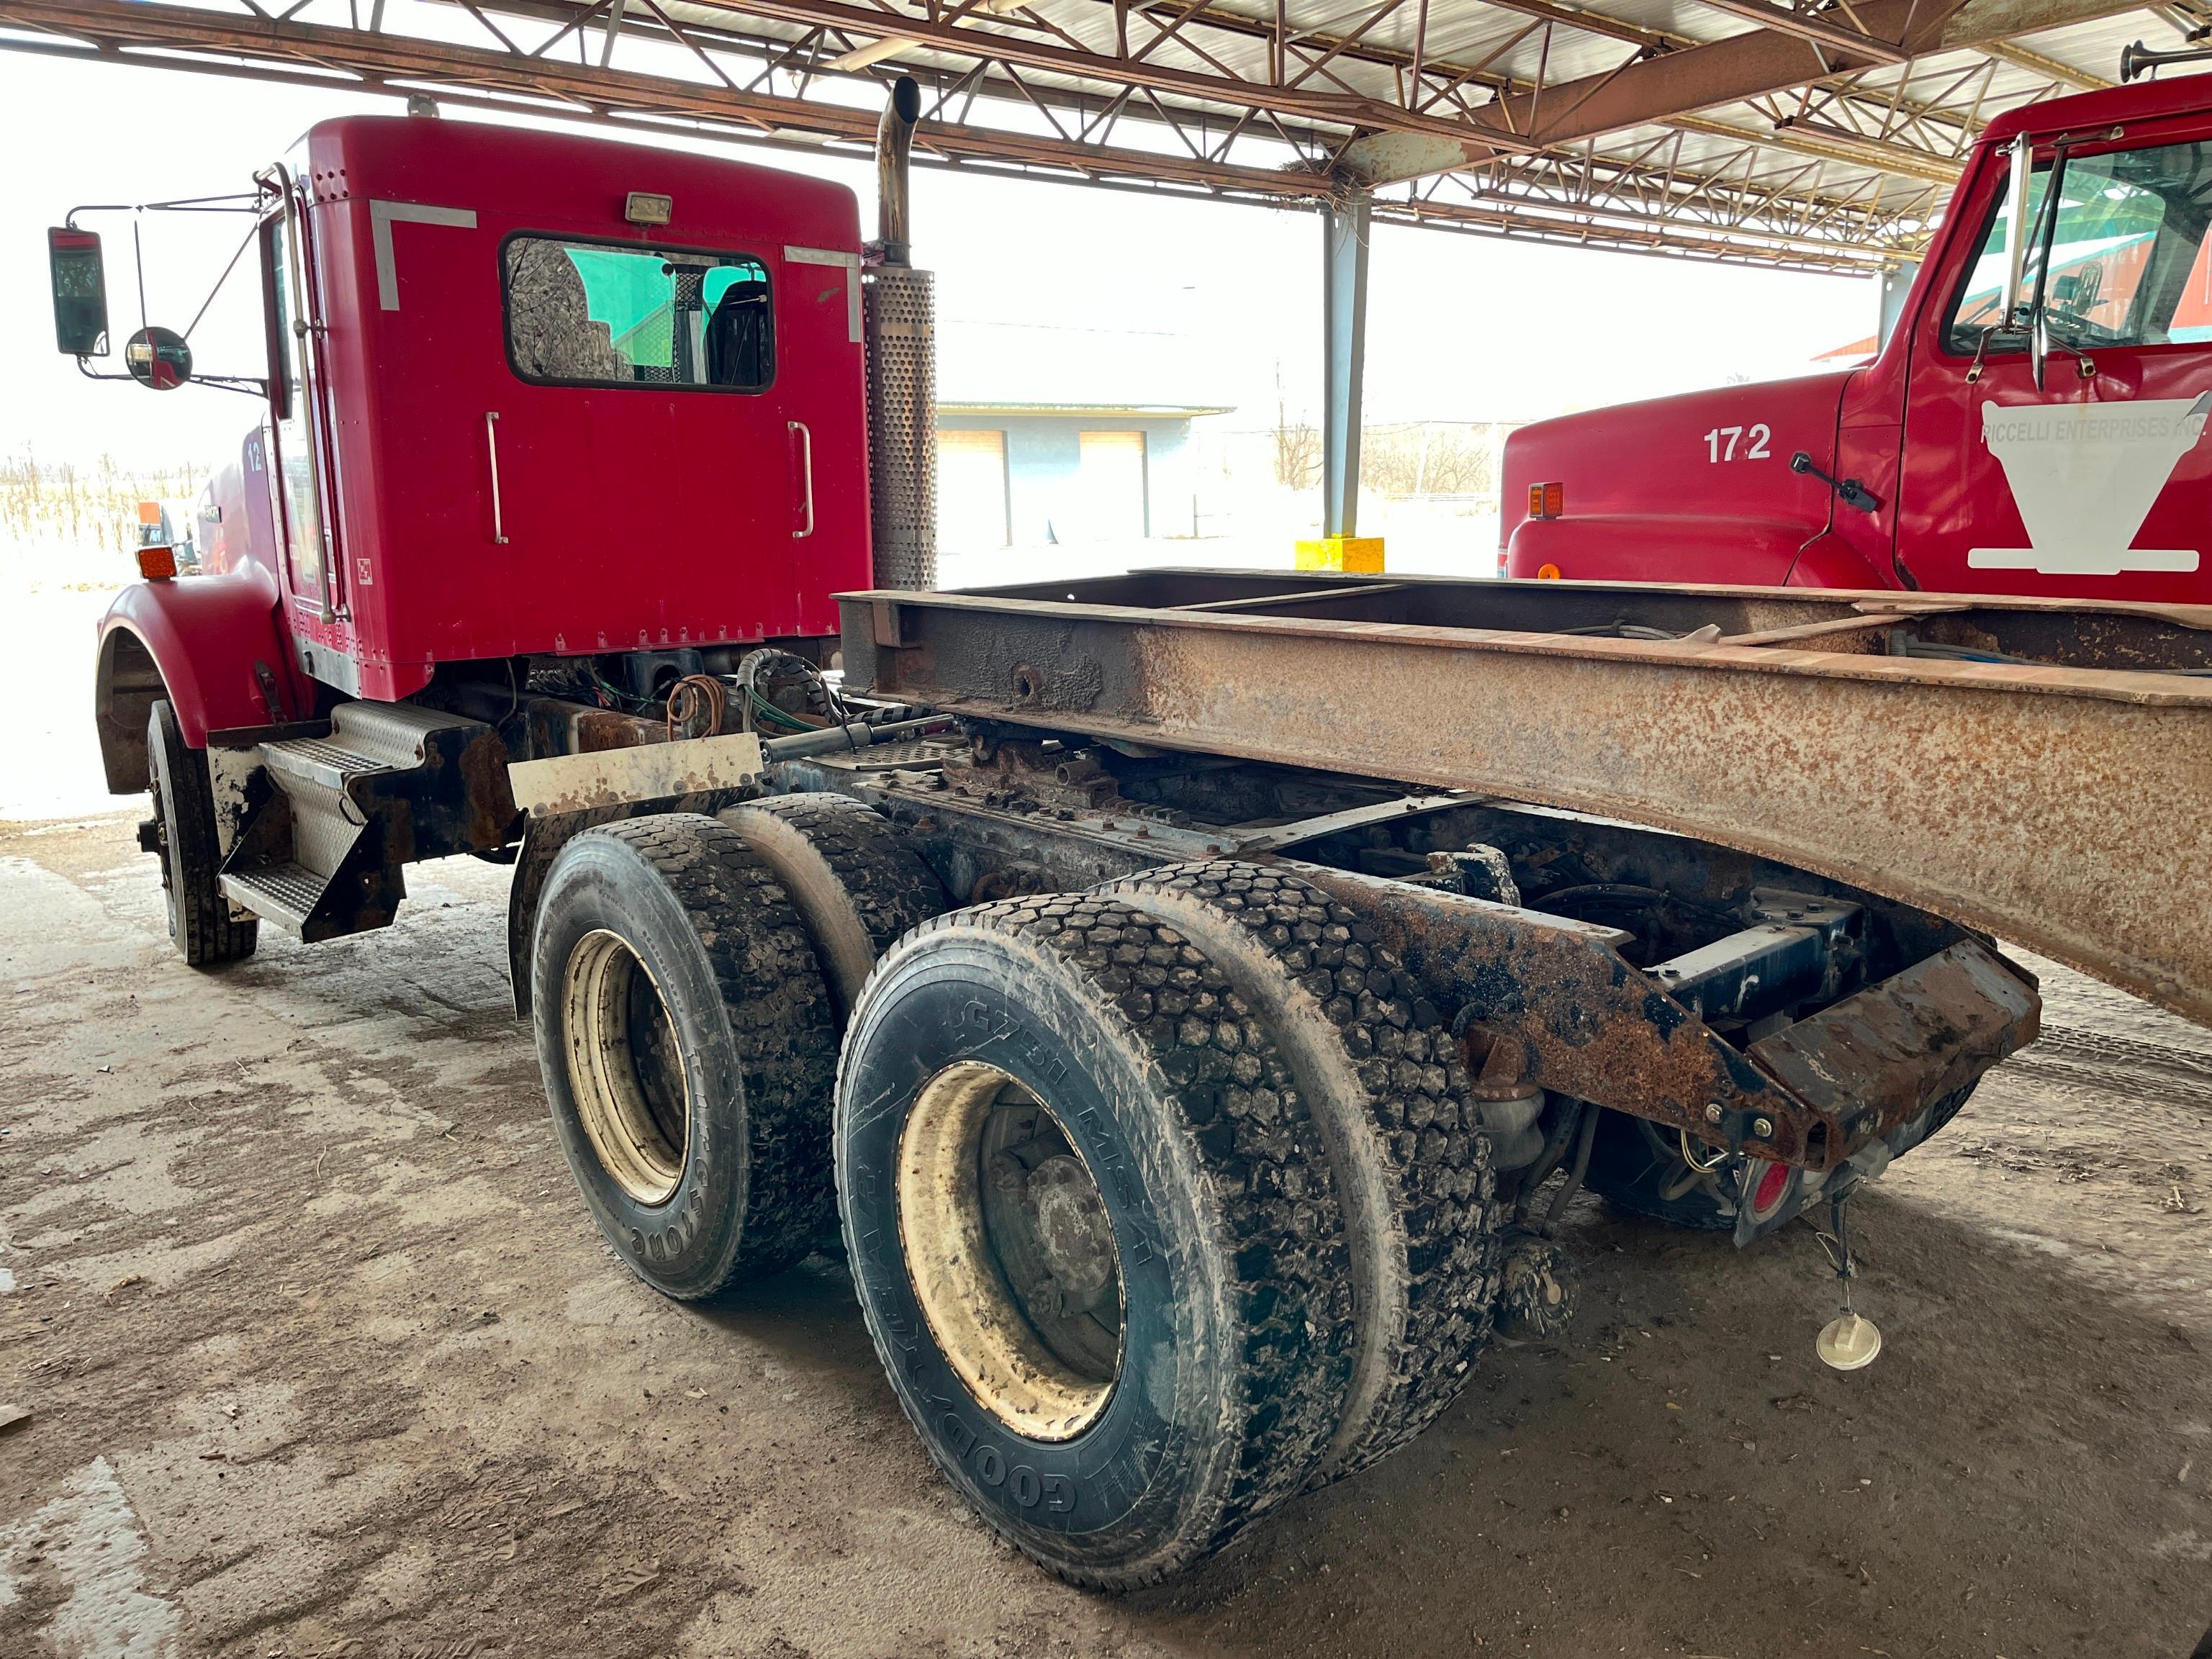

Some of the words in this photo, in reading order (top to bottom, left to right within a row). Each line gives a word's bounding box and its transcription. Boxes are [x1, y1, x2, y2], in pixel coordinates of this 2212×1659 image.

[1704, 423, 1771, 463] 172
[1981, 421, 2051, 443] RICCELLI
[2055, 416, 2171, 440] ENTERPRISES
[857, 1164, 1078, 1512] GOODYEAR
